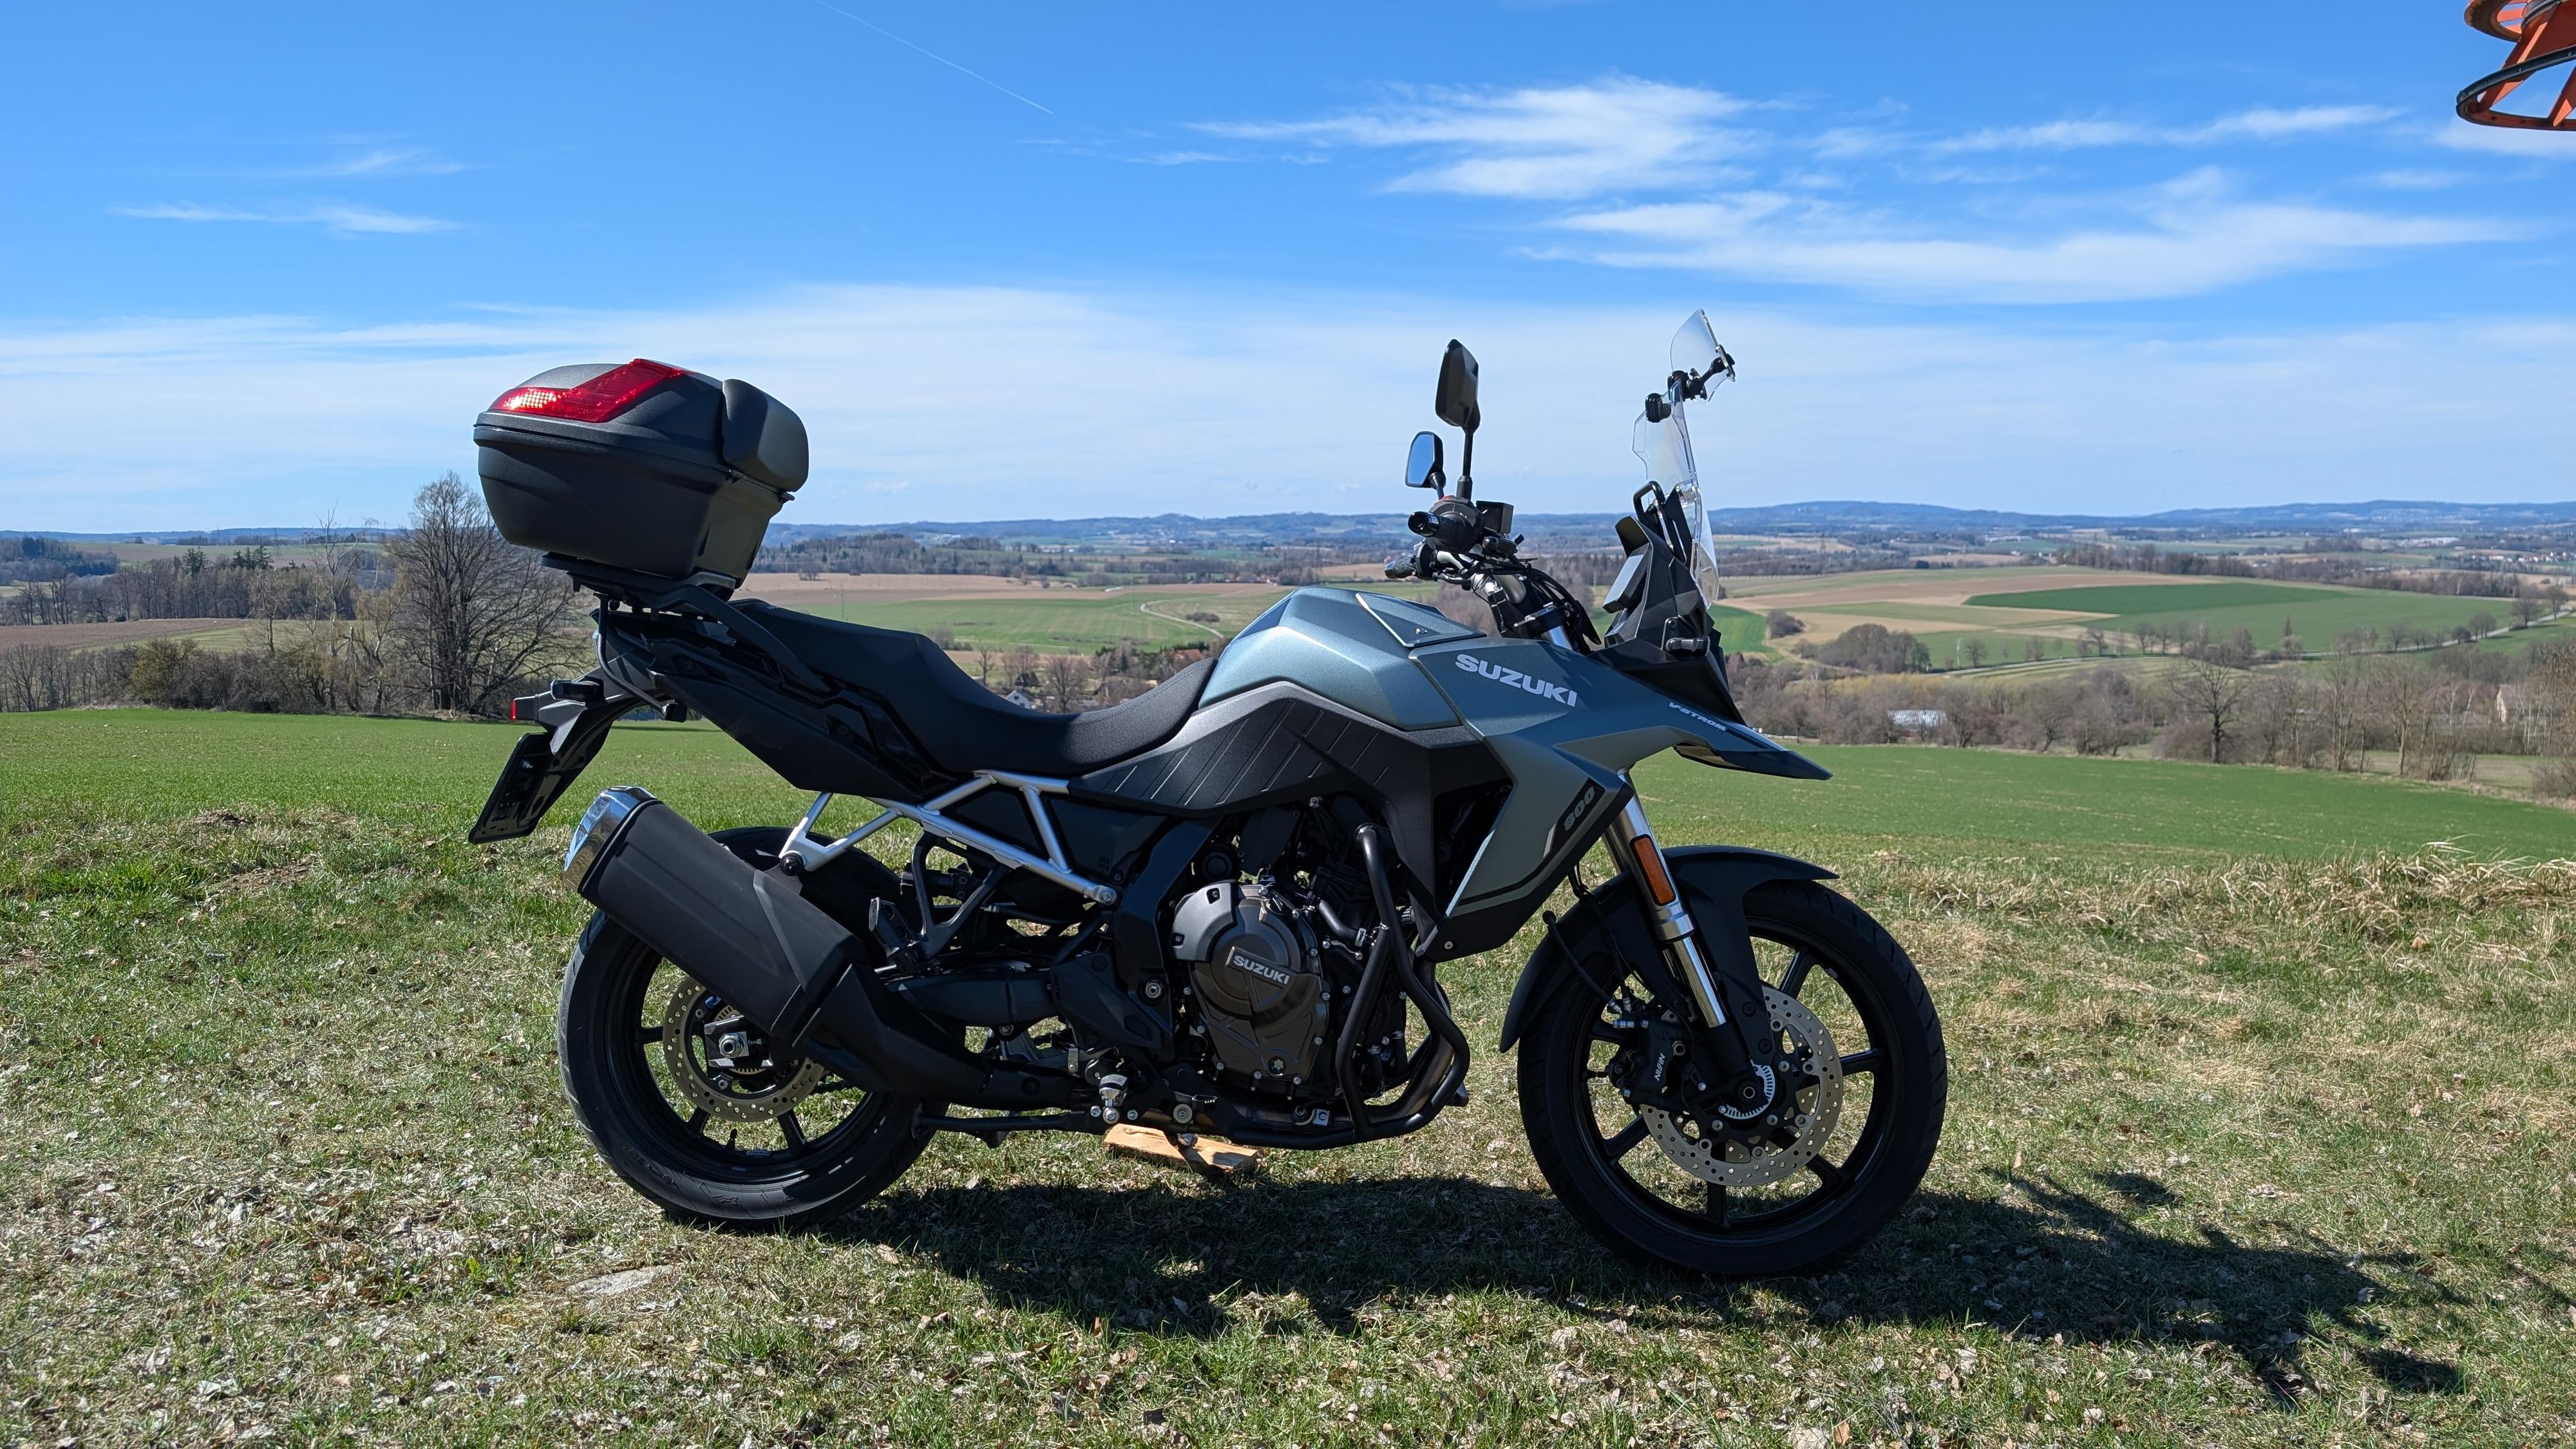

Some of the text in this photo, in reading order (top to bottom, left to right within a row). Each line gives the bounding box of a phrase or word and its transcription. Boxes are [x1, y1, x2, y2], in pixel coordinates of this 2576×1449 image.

[1455, 654, 1577, 707] SUZUKI
[1564, 786, 1595, 831] 800
[1233, 955, 1290, 985] SUZUKI
